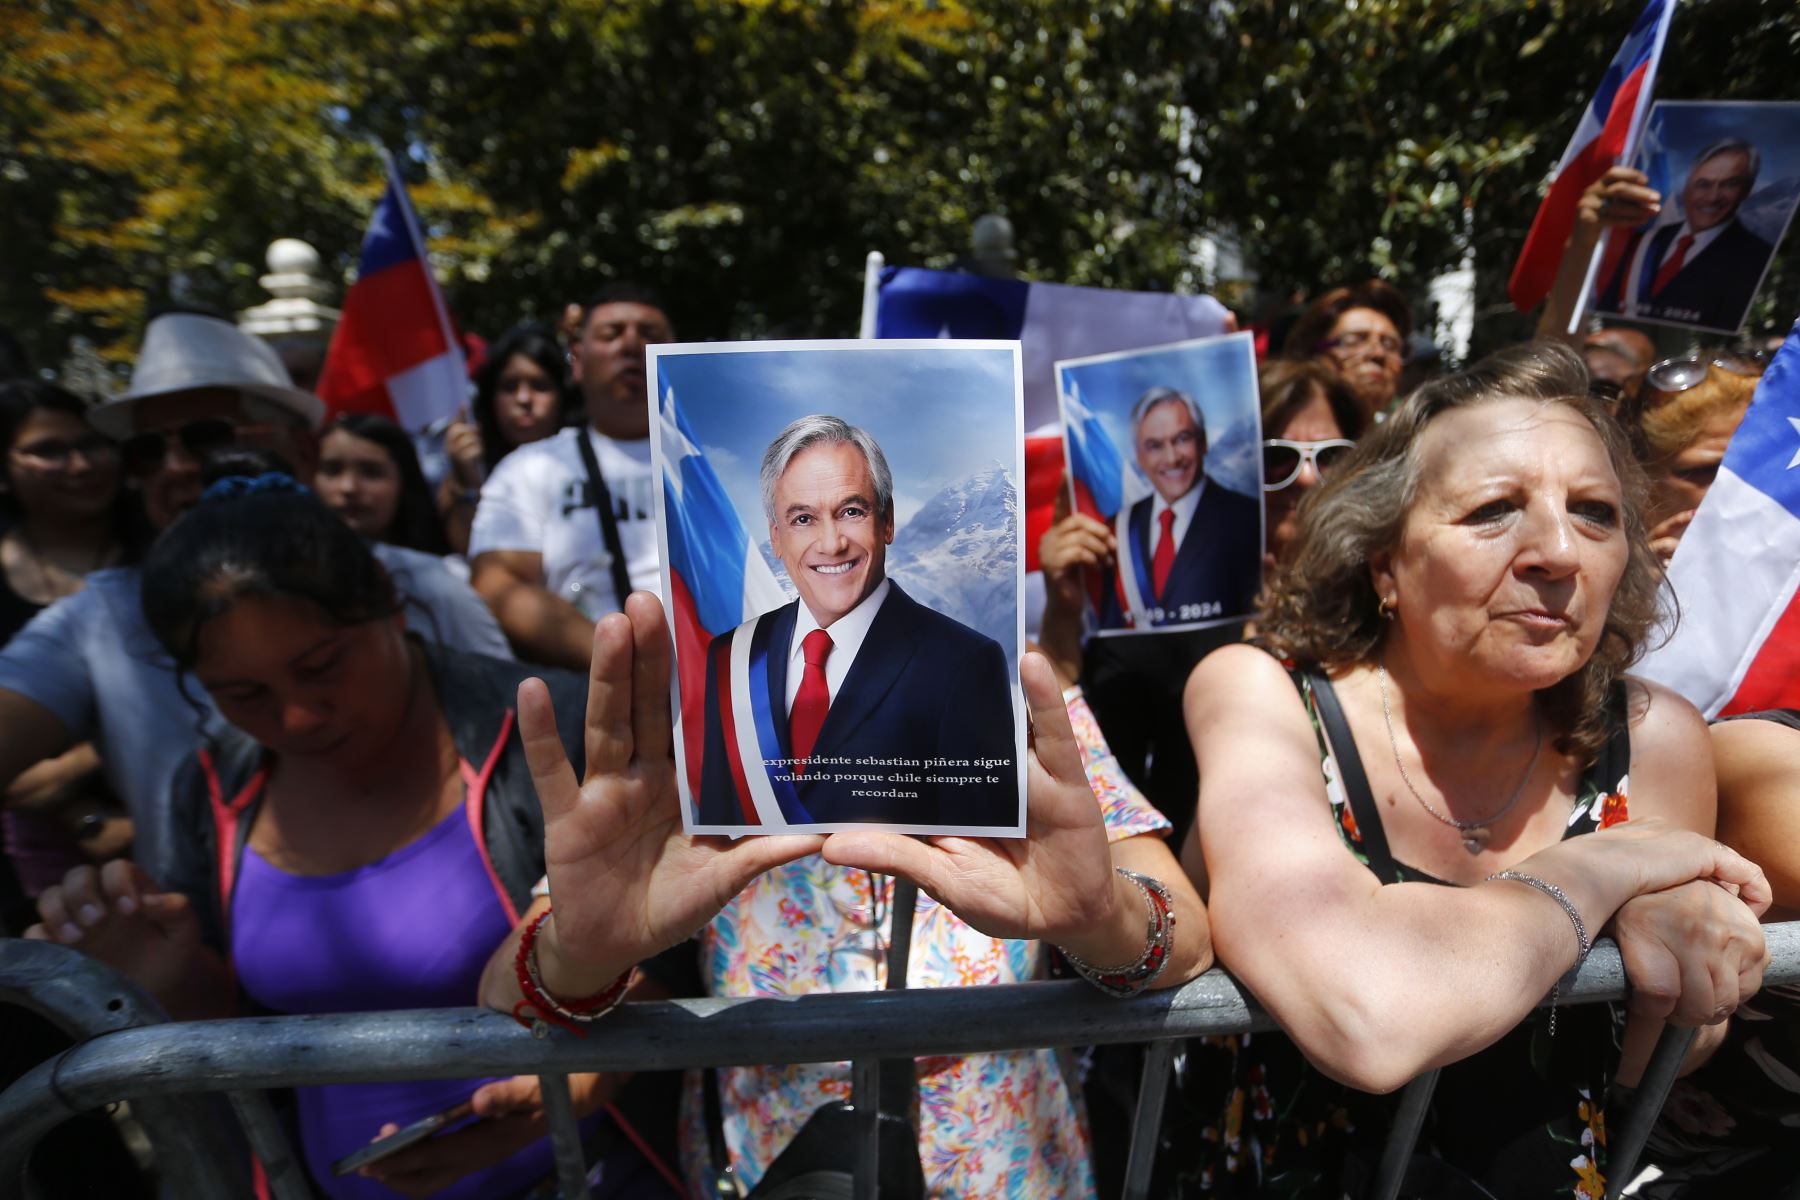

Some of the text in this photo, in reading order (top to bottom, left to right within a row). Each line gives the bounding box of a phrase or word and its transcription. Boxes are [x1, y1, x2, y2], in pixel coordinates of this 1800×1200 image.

[1179, 600, 1222, 621] 2024
[763, 755, 1011, 769] expresidente sebastian piñera sigue
[774, 771, 999, 786] volando porque chile siempre te
[850, 788, 919, 798] recordara
